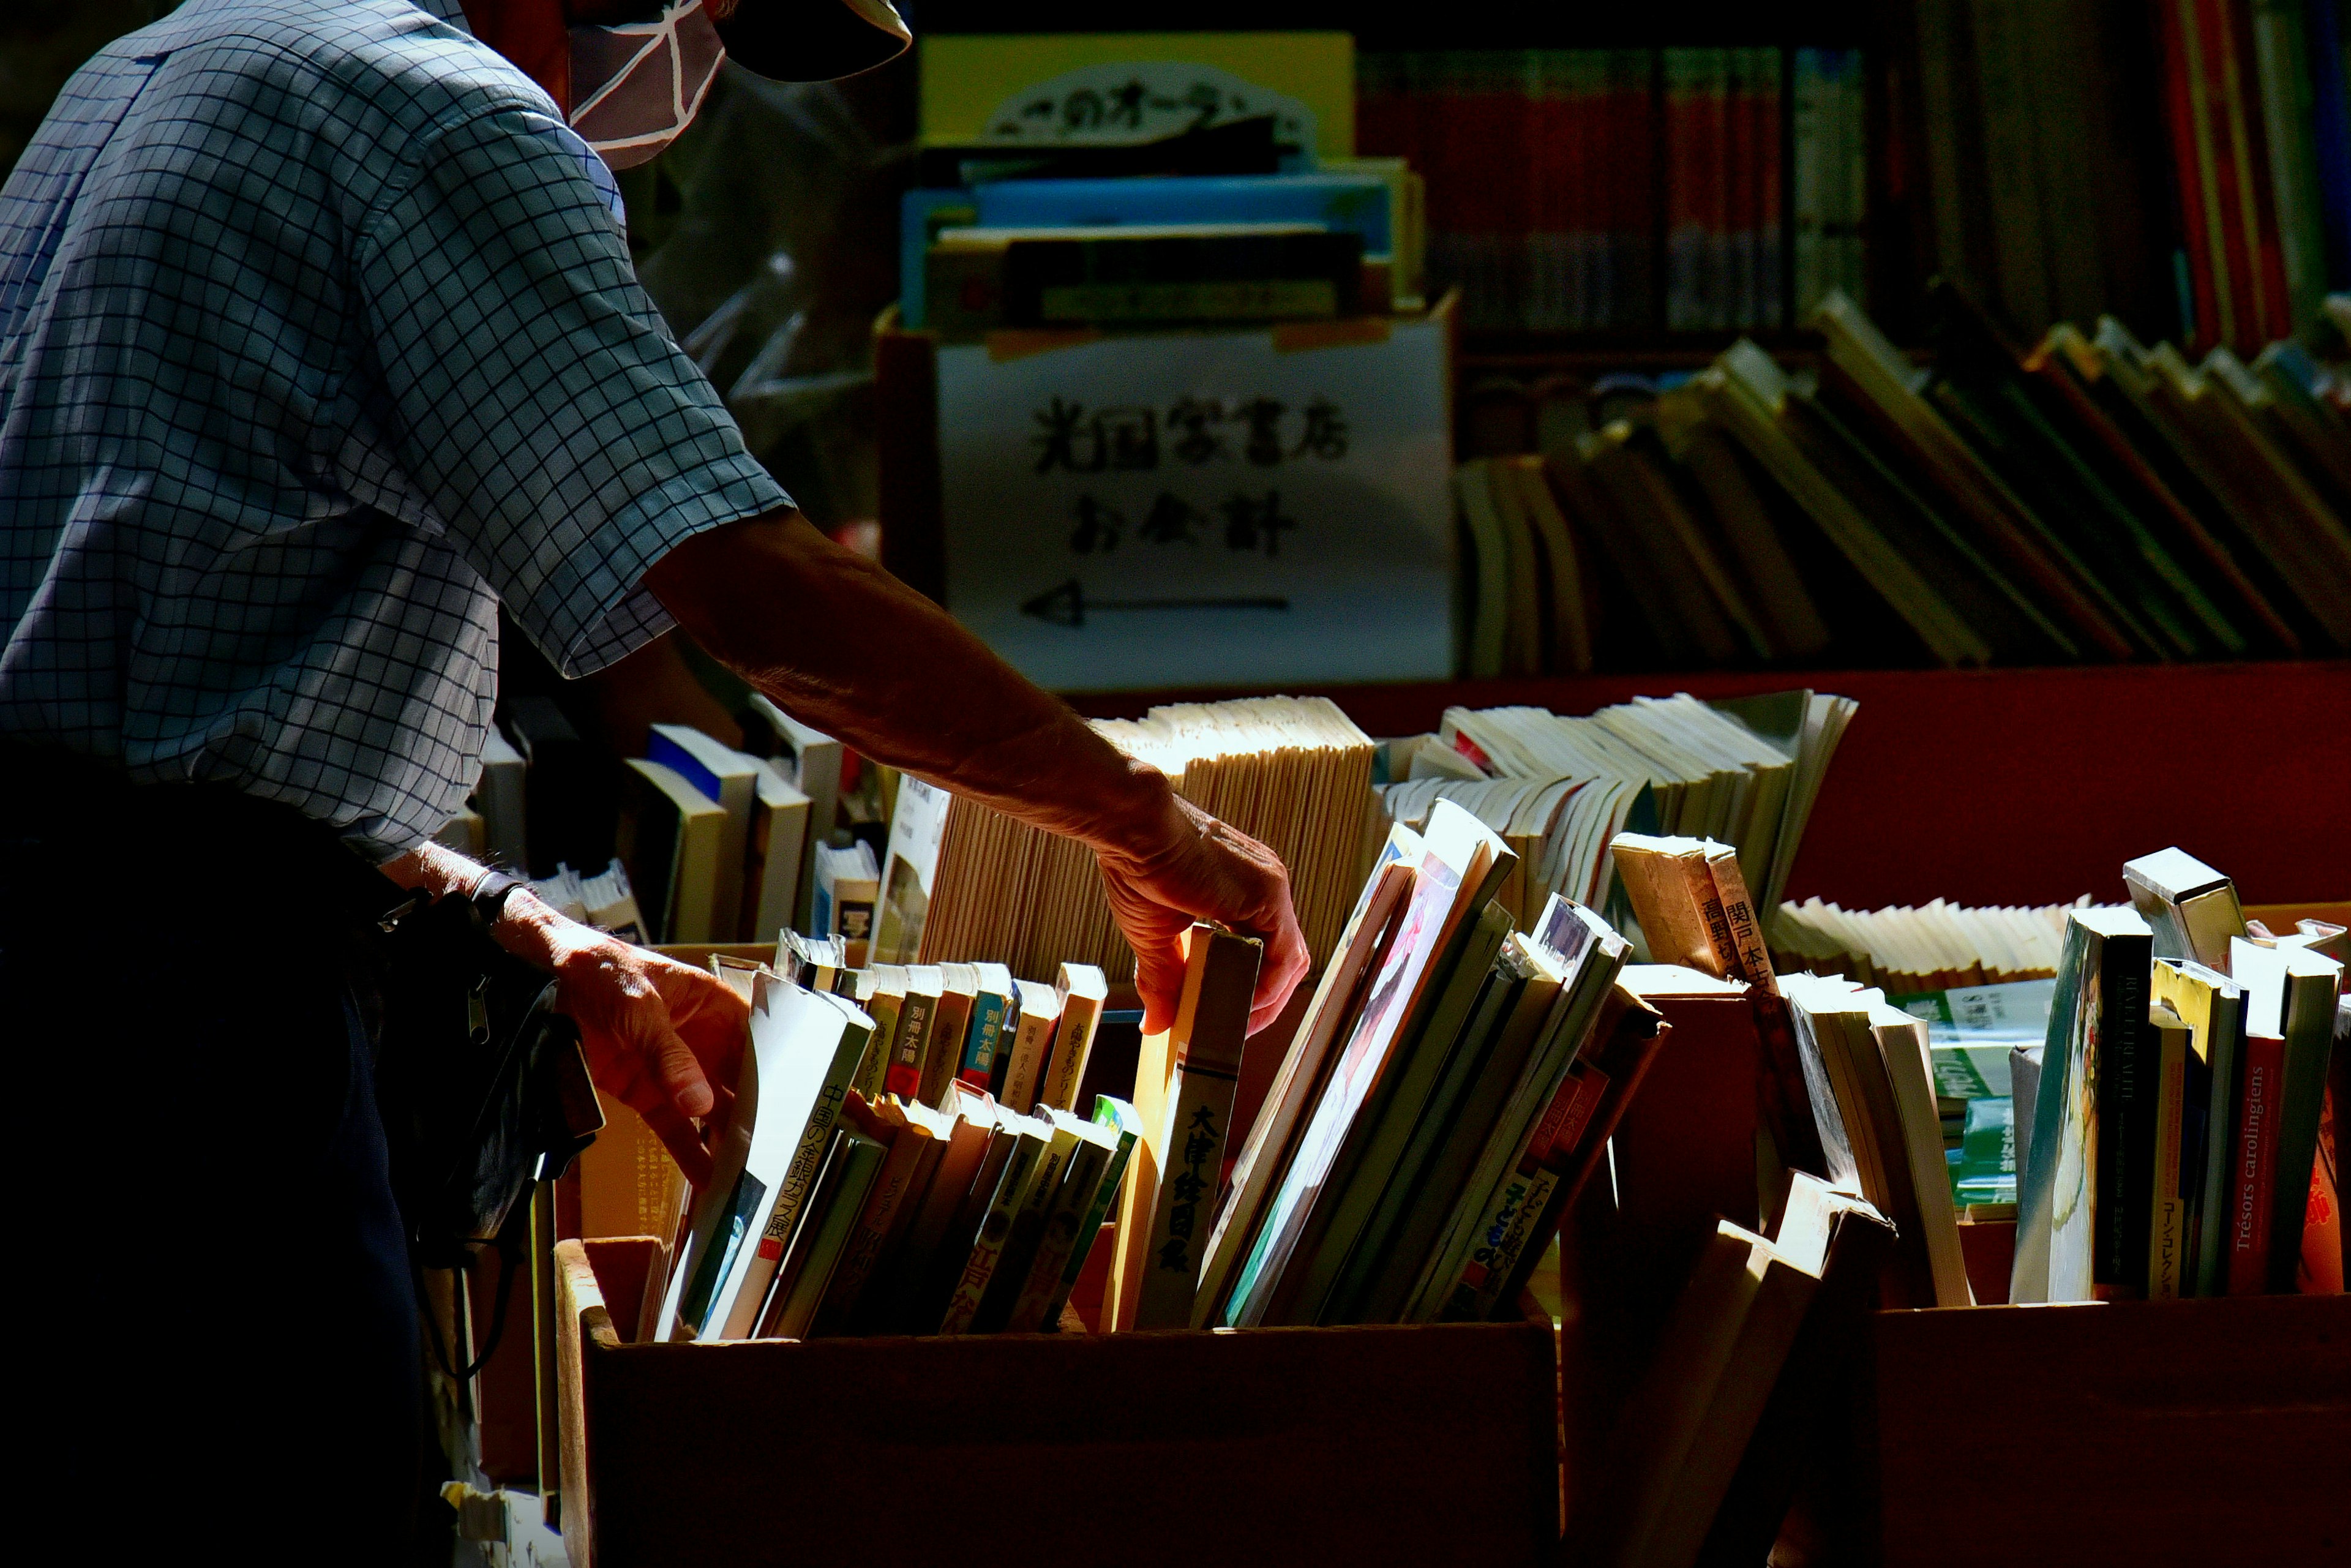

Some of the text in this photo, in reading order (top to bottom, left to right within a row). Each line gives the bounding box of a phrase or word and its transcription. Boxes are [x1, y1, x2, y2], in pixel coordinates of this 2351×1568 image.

[1071, 490, 1298, 555] お会計
[864, 1020, 887, 1102] 太陽やきものシリー
[901, 1006, 926, 1063] 別冊太陽
[975, 1009, 1000, 1067] 別冊太陽
[1056, 1023, 1085, 1109] 太陽やきものシリーズ
[766, 1084, 843, 1242] 中国の金銀ガラス展
[2237, 1066, 2263, 1251] Trésors carolingiens
